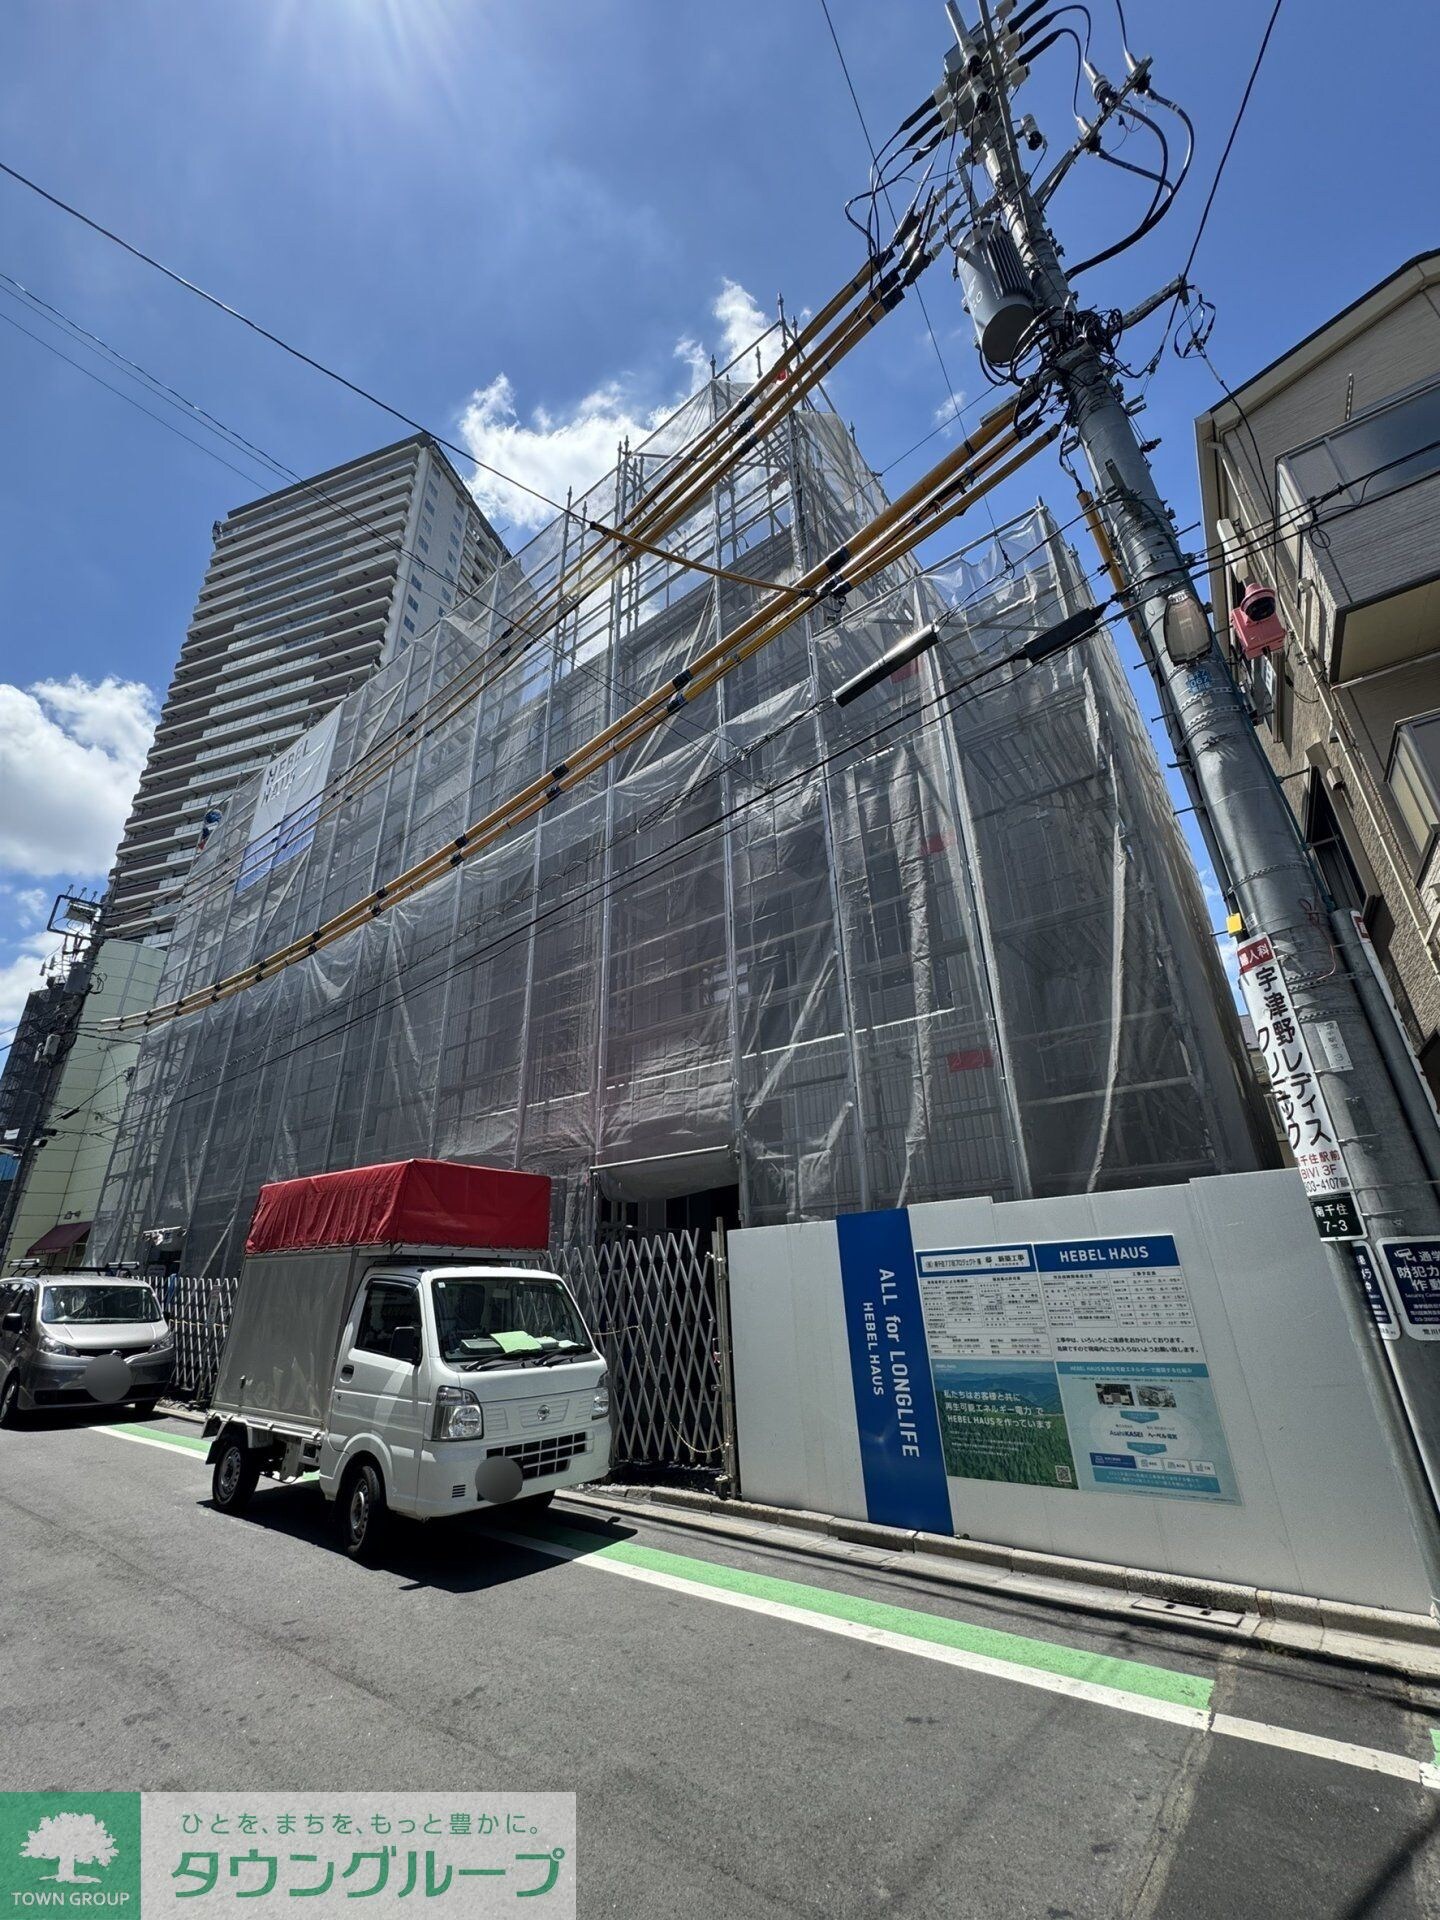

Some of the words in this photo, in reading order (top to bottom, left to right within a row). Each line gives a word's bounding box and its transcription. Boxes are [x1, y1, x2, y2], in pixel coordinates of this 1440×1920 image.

[1239, 942, 1270, 968] 人科
[1255, 965, 1332, 1146] 宇津野レディス
[1299, 1149, 1341, 1167] 千住駅前
[1322, 1163, 1338, 1177] 3F
[1314, 1203, 1349, 1218] 南千住
[1322, 1219, 1349, 1233] 7-3
[1059, 1249, 1107, 1263] HEBEL
[1108, 1246, 1150, 1260] HAUS
[878, 1268, 898, 1306] ALL
[863, 1302, 878, 1351] HEBEL
[885, 1315, 902, 1343] for
[869, 1354, 884, 1396] HAUS
[889, 1350, 921, 1458] LONGLIFE
